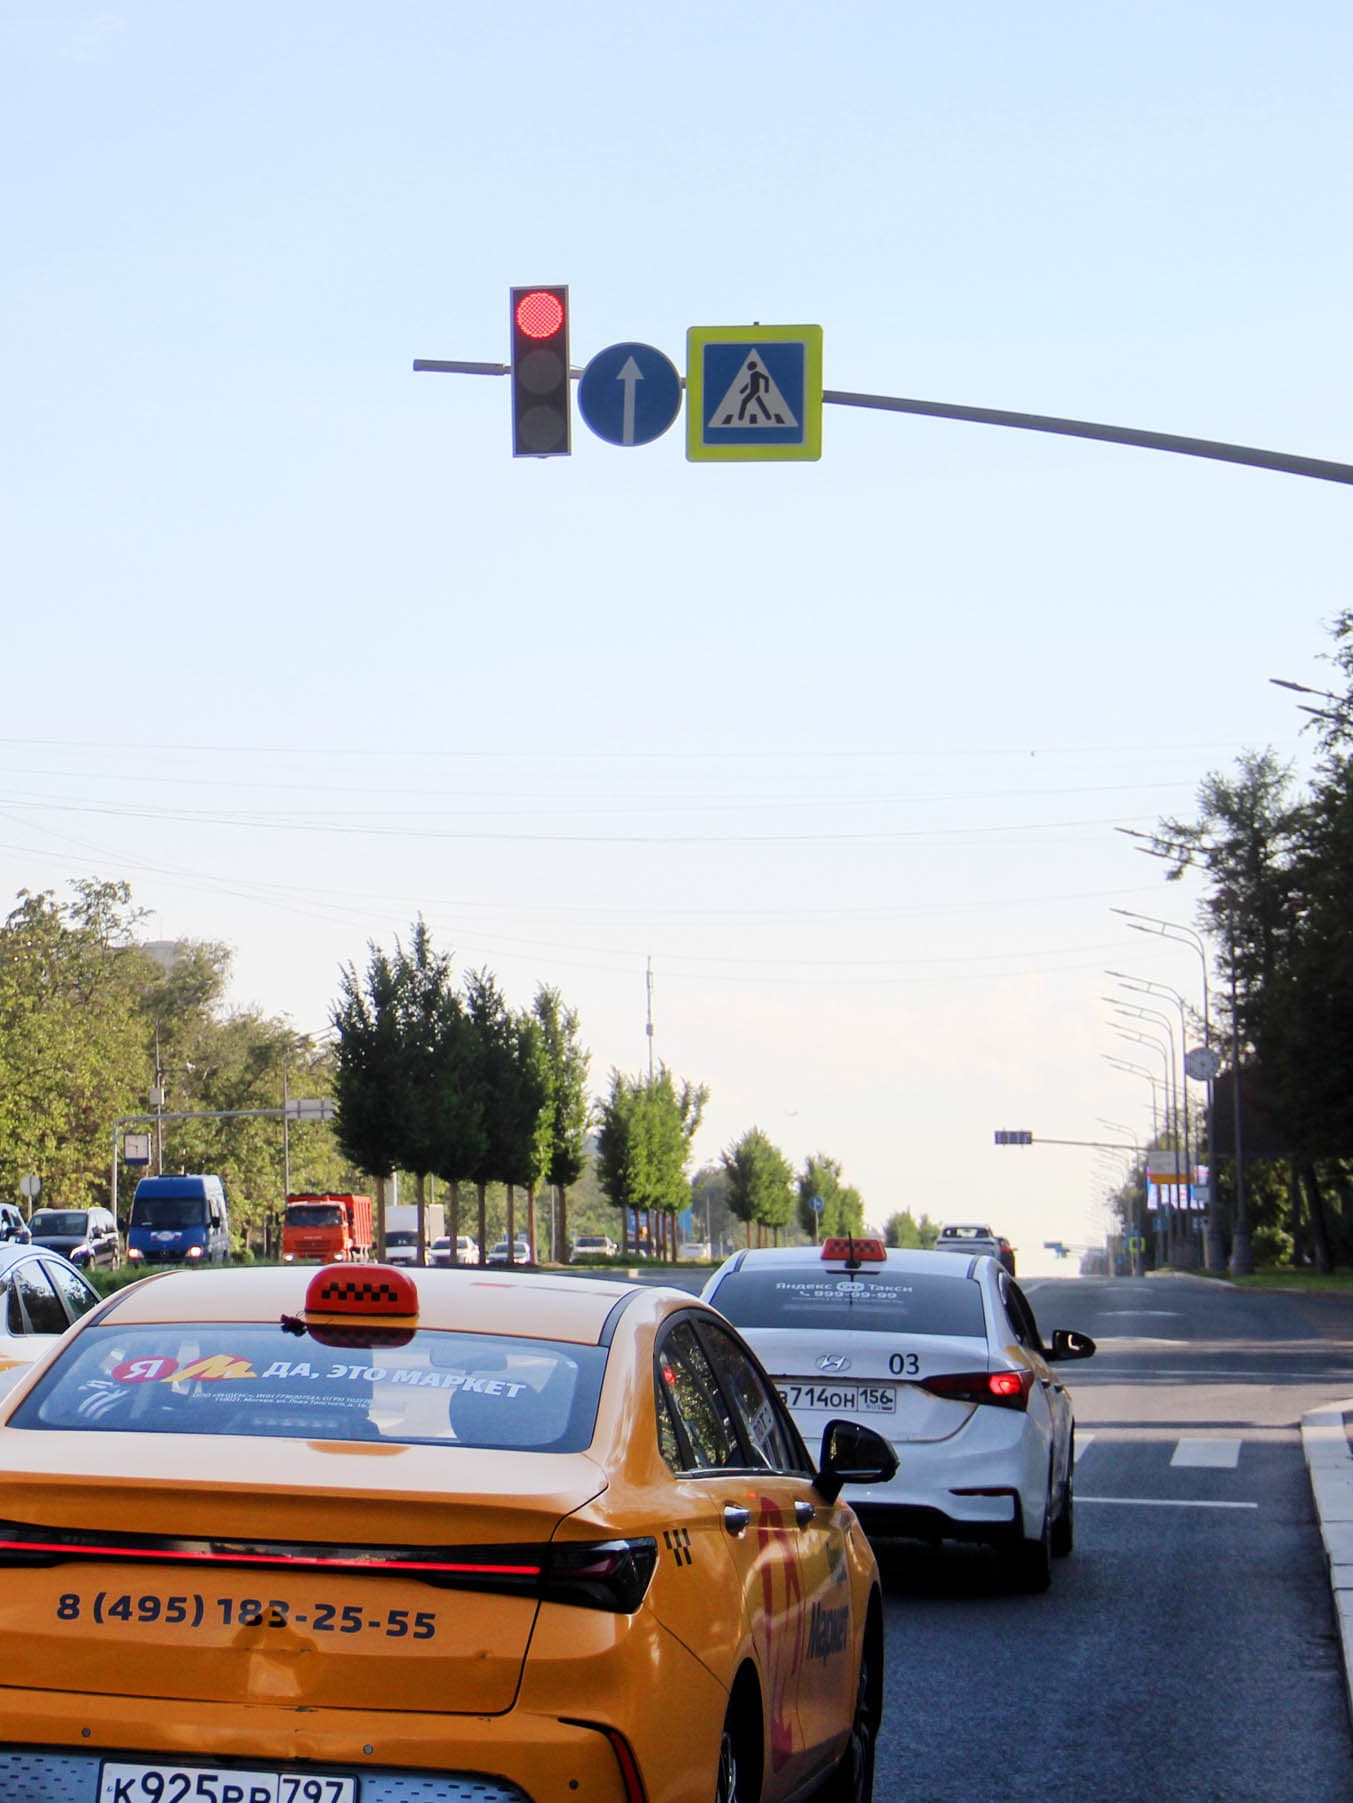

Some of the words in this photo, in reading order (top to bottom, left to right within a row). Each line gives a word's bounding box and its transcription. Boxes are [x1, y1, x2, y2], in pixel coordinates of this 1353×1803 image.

[775, 1281, 833, 1291] Яндекс
[868, 1283, 913, 1293] Такси
[888, 1353, 919, 1375] 03
[122, 1359, 165, 1379] Я
[261, 1361, 319, 1380] ДА,
[326, 1364, 386, 1381] ЭТО
[391, 1368, 527, 1398] МАРКЕТ
[859, 1389, 888, 1404] 156
[56, 1594, 81, 1620] 8
[93, 1592, 205, 1627] (495)
[217, 1598, 437, 1640] 183-25-55
[283, 1778, 344, 1803] 797
